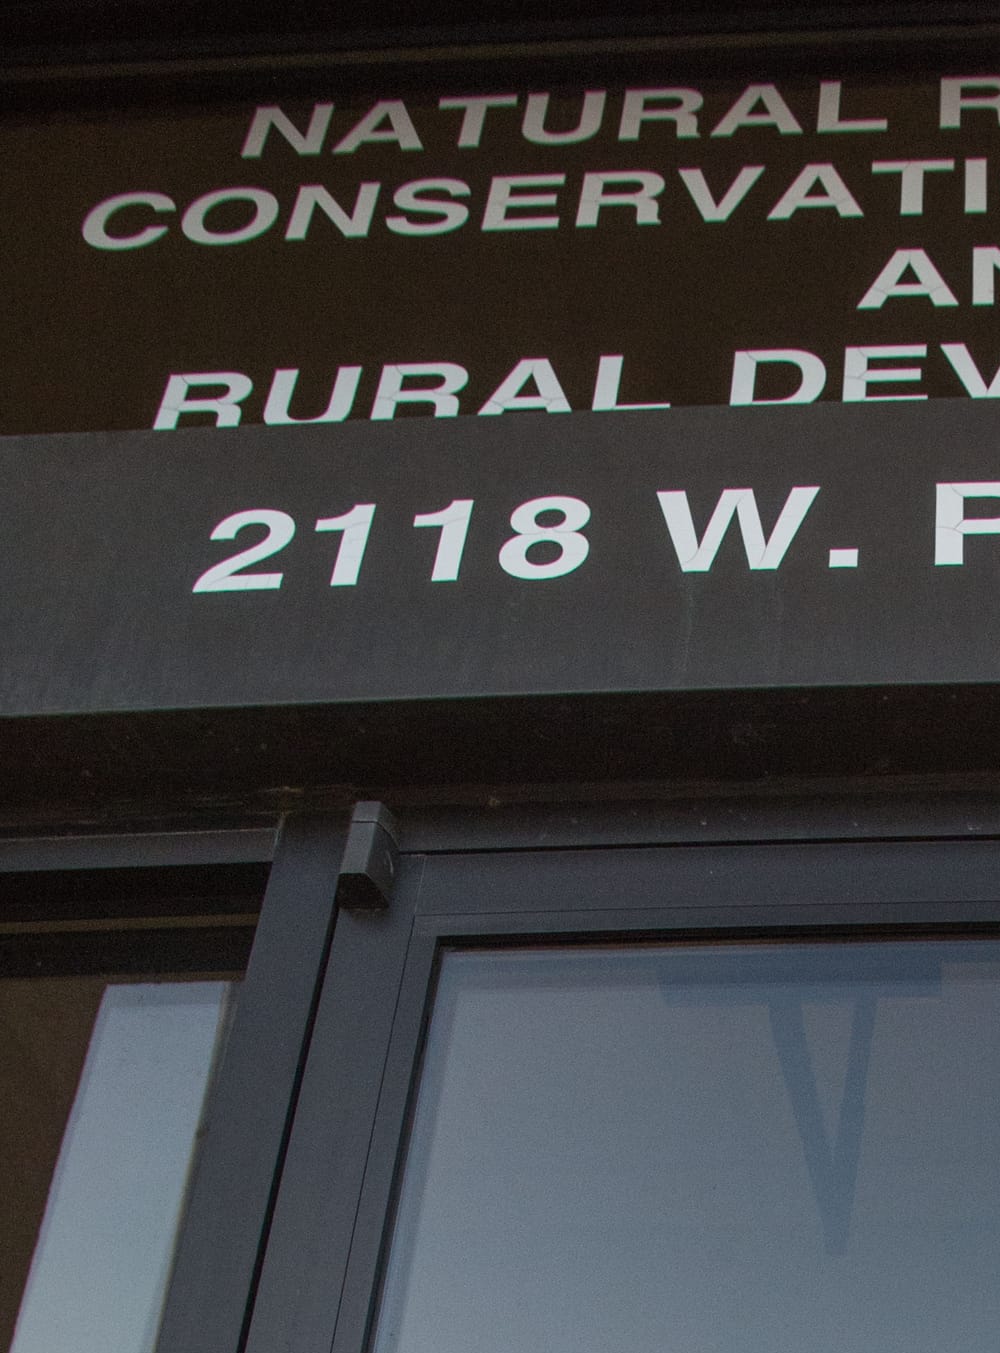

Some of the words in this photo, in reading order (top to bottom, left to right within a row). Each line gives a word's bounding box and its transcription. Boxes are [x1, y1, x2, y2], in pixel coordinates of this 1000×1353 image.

[242, 82, 888, 157] NATURAL
[153, 356, 670, 430] RURAL
[193, 496, 590, 593] 2118
[657, 487, 858, 573] W.
